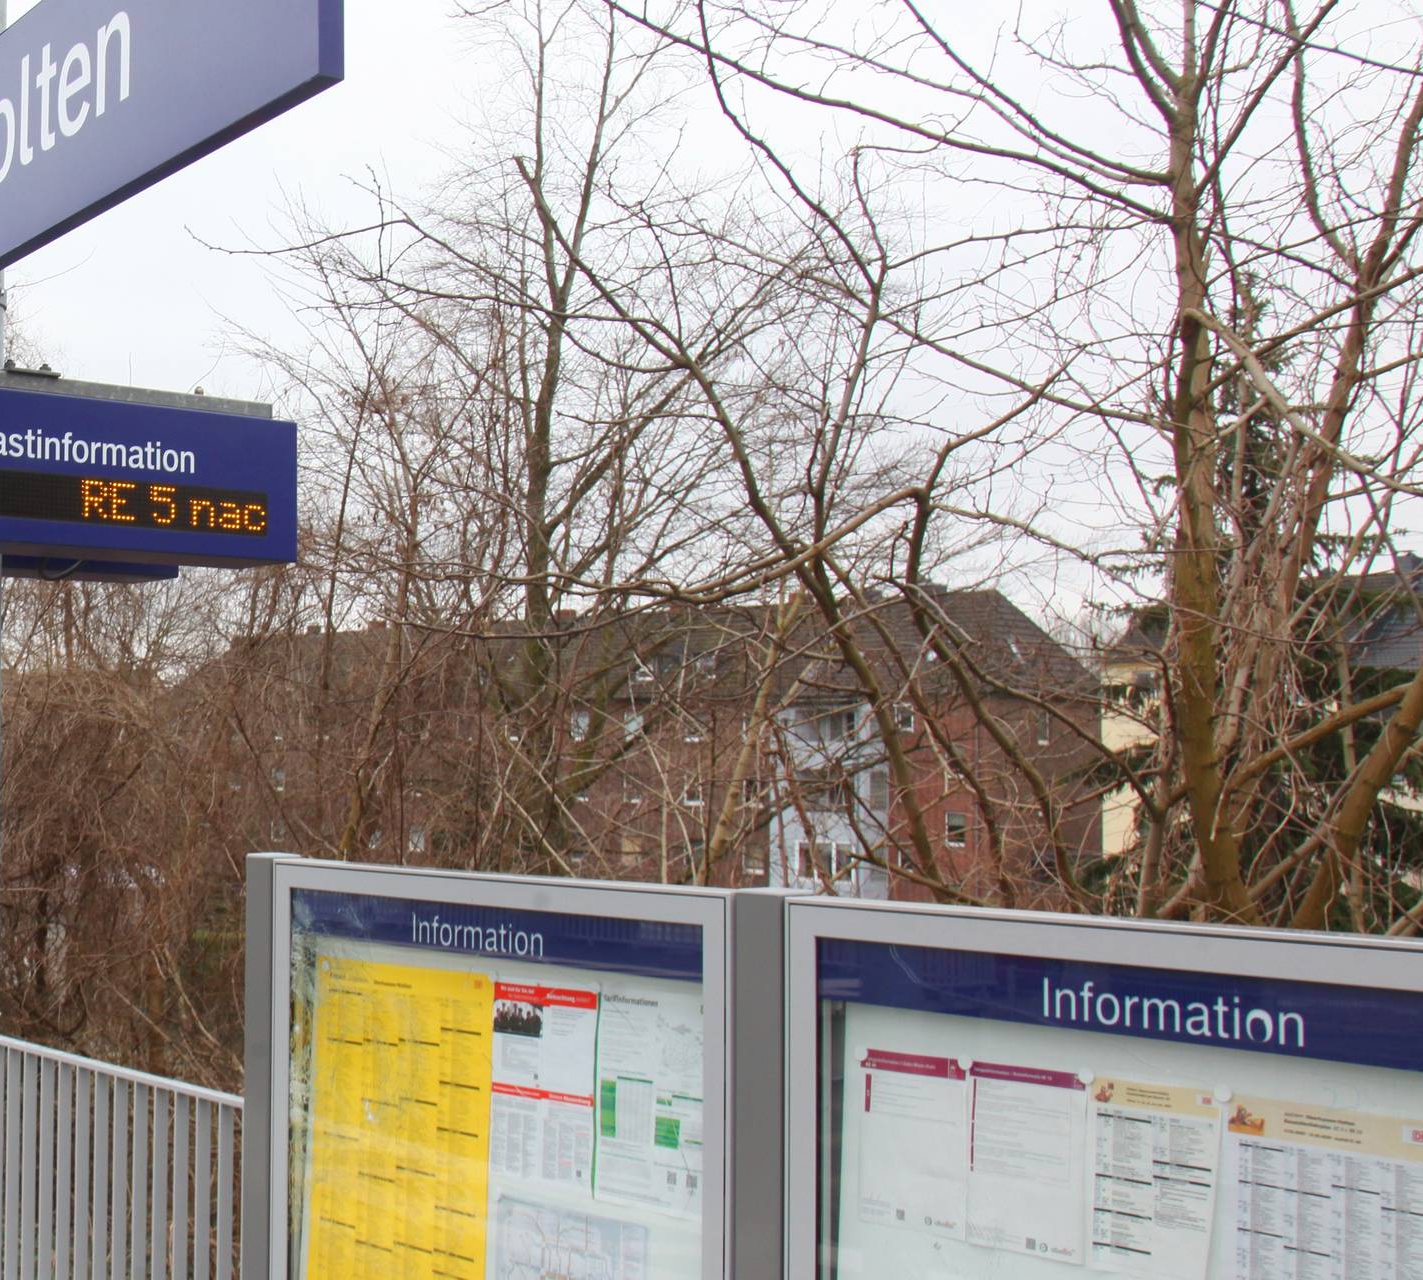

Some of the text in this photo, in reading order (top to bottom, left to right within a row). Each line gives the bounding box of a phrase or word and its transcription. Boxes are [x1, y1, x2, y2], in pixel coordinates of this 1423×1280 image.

[80, 479, 136, 521] RE
[150, 484, 177, 524] 5
[189, 499, 267, 532] nac
[411, 911, 544, 961] Information
[1041, 976, 1306, 1048] Information
